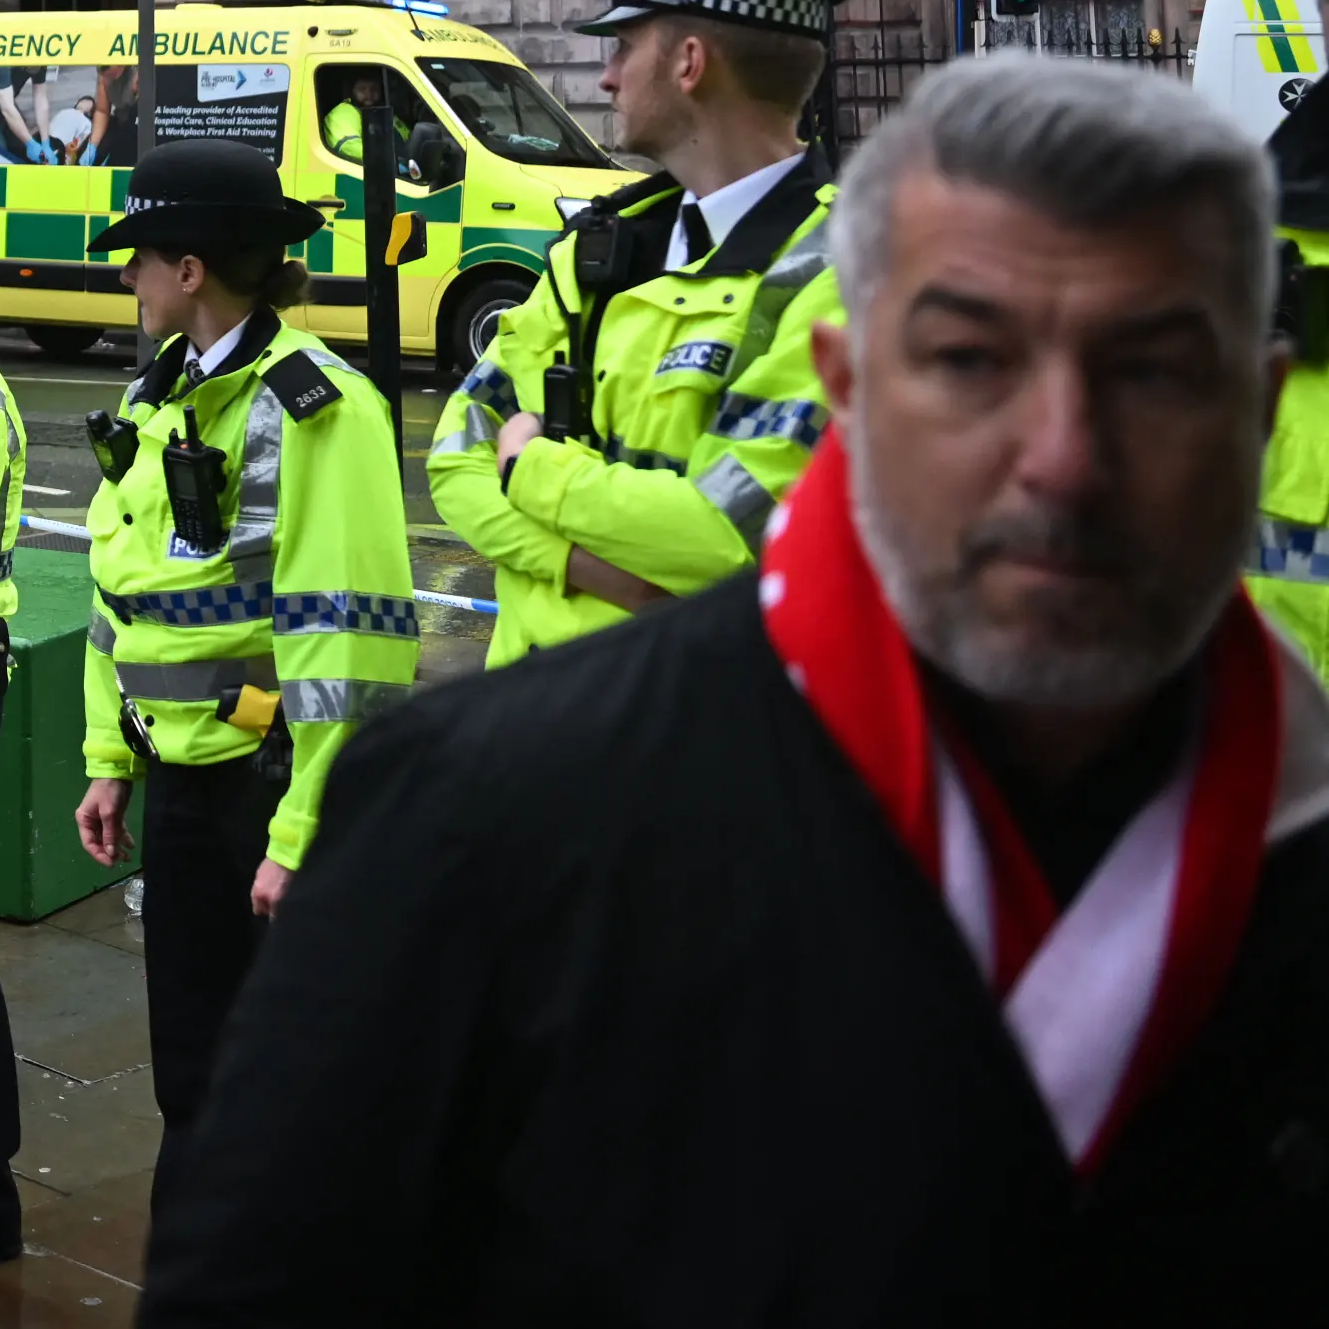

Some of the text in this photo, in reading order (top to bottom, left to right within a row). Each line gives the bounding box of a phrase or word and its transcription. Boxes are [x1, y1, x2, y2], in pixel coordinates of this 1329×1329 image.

[155, 105, 279, 116] A leading provider of Accredited
[184, 117, 204, 126] Care,
[206, 117, 235, 125] Clinical
[236, 117, 277, 125] Education
[165, 127, 205, 137] Workplace
[206, 127, 225, 136] First
[226, 127, 241, 136] Aid
[241, 128, 277, 138] Training
[661, 345, 727, 371] POLICE
[295, 385, 326, 408] 2633
